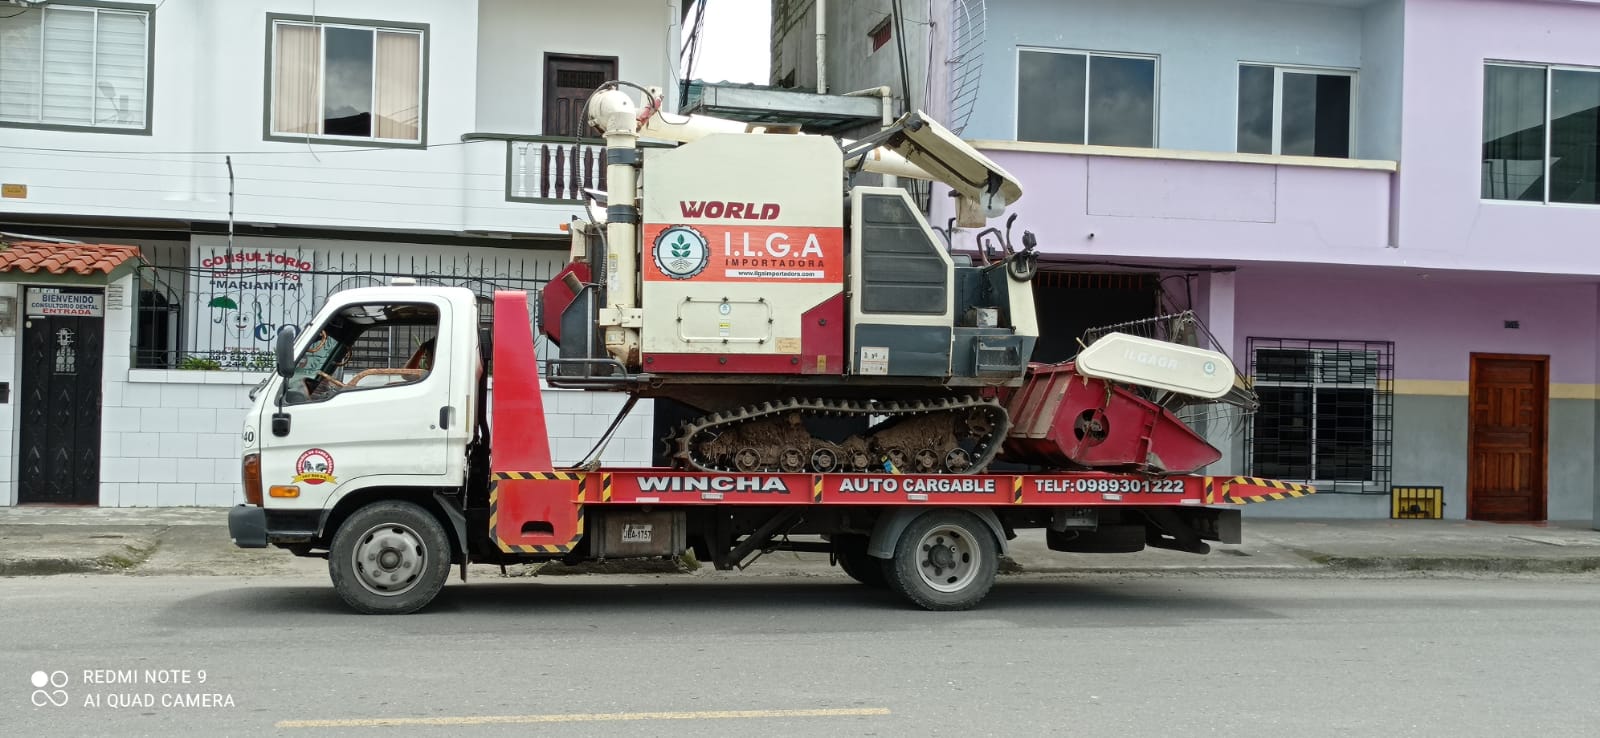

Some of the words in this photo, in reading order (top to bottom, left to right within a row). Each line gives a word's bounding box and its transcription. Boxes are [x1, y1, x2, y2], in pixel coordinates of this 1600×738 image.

[680, 200, 781, 220] WORLD
[724, 231, 824, 258] I.L.G.A
[202, 252, 311, 271] CONSULTORIO
[725, 258, 825, 268] IMPORTADORA
[42, 294, 94, 304] BIENVENIDO
[637, 476, 789, 493] WINCHA
[839, 478, 899, 492] AUTO
[903, 478, 995, 493] CARGABLE
